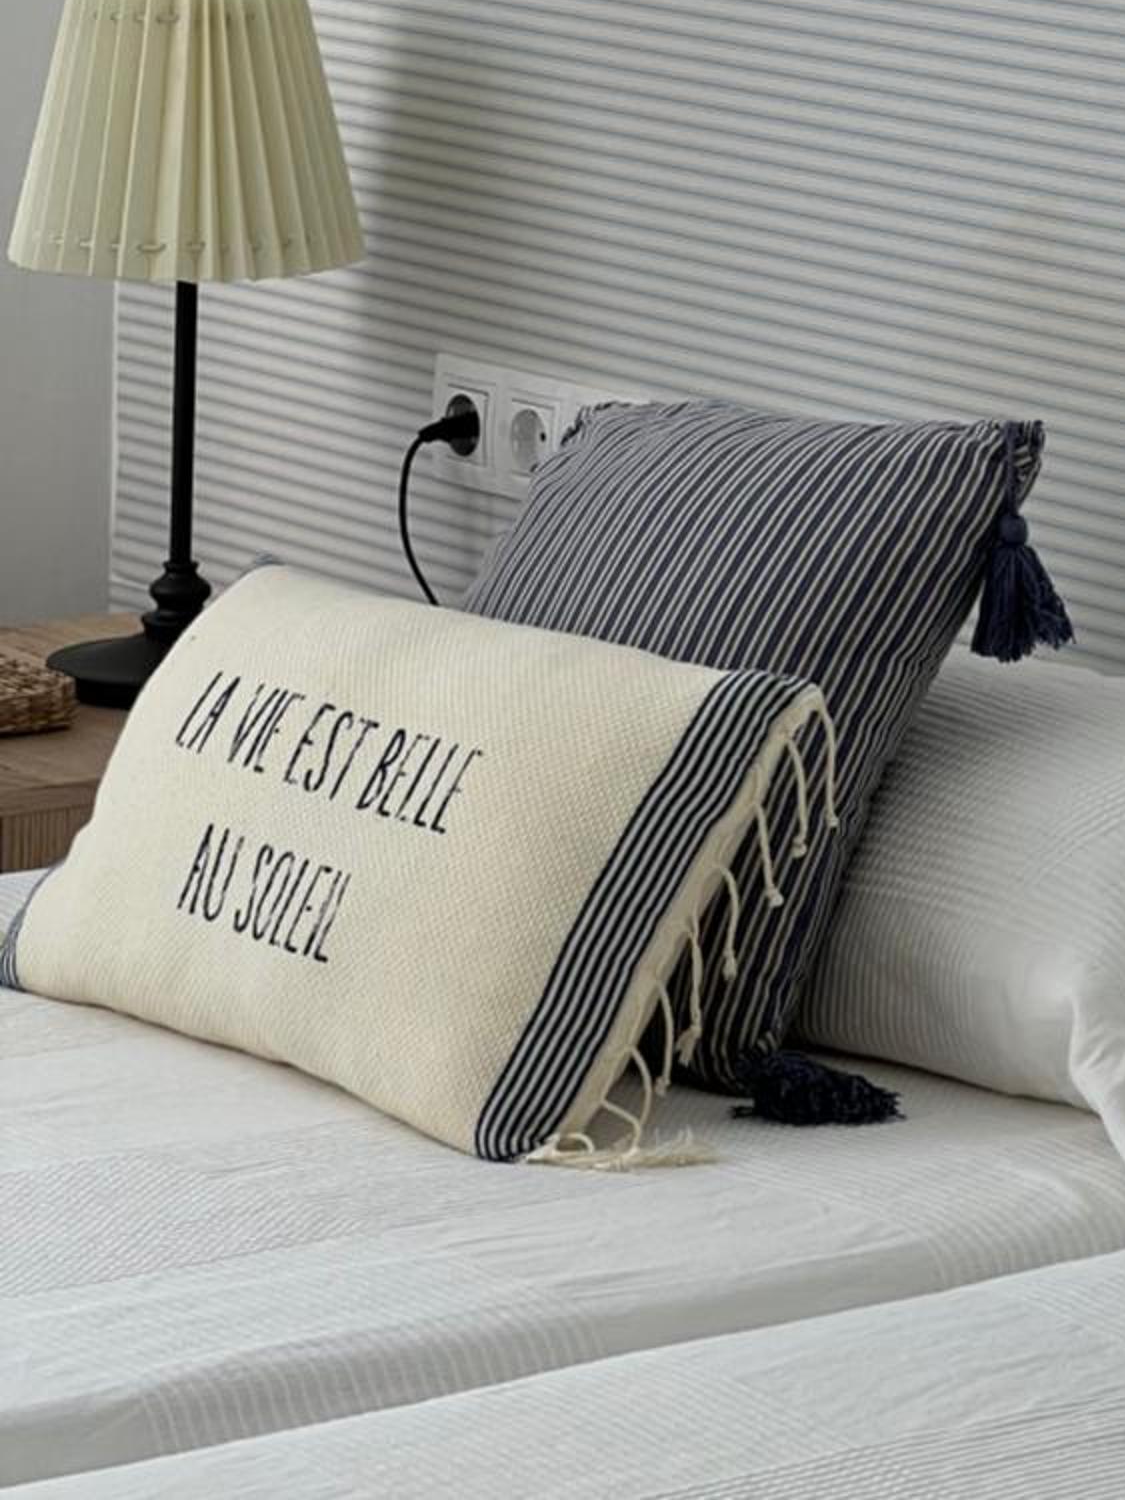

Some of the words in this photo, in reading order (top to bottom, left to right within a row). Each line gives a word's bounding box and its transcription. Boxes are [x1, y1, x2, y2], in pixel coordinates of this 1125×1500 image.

[175, 671, 241, 754] LA
[227, 683, 306, 773] VIE
[283, 702, 380, 800] EST
[355, 728, 484, 834] BELLE
[177, 822, 245, 922] AU
[232, 843, 351, 963] SOLEIL
